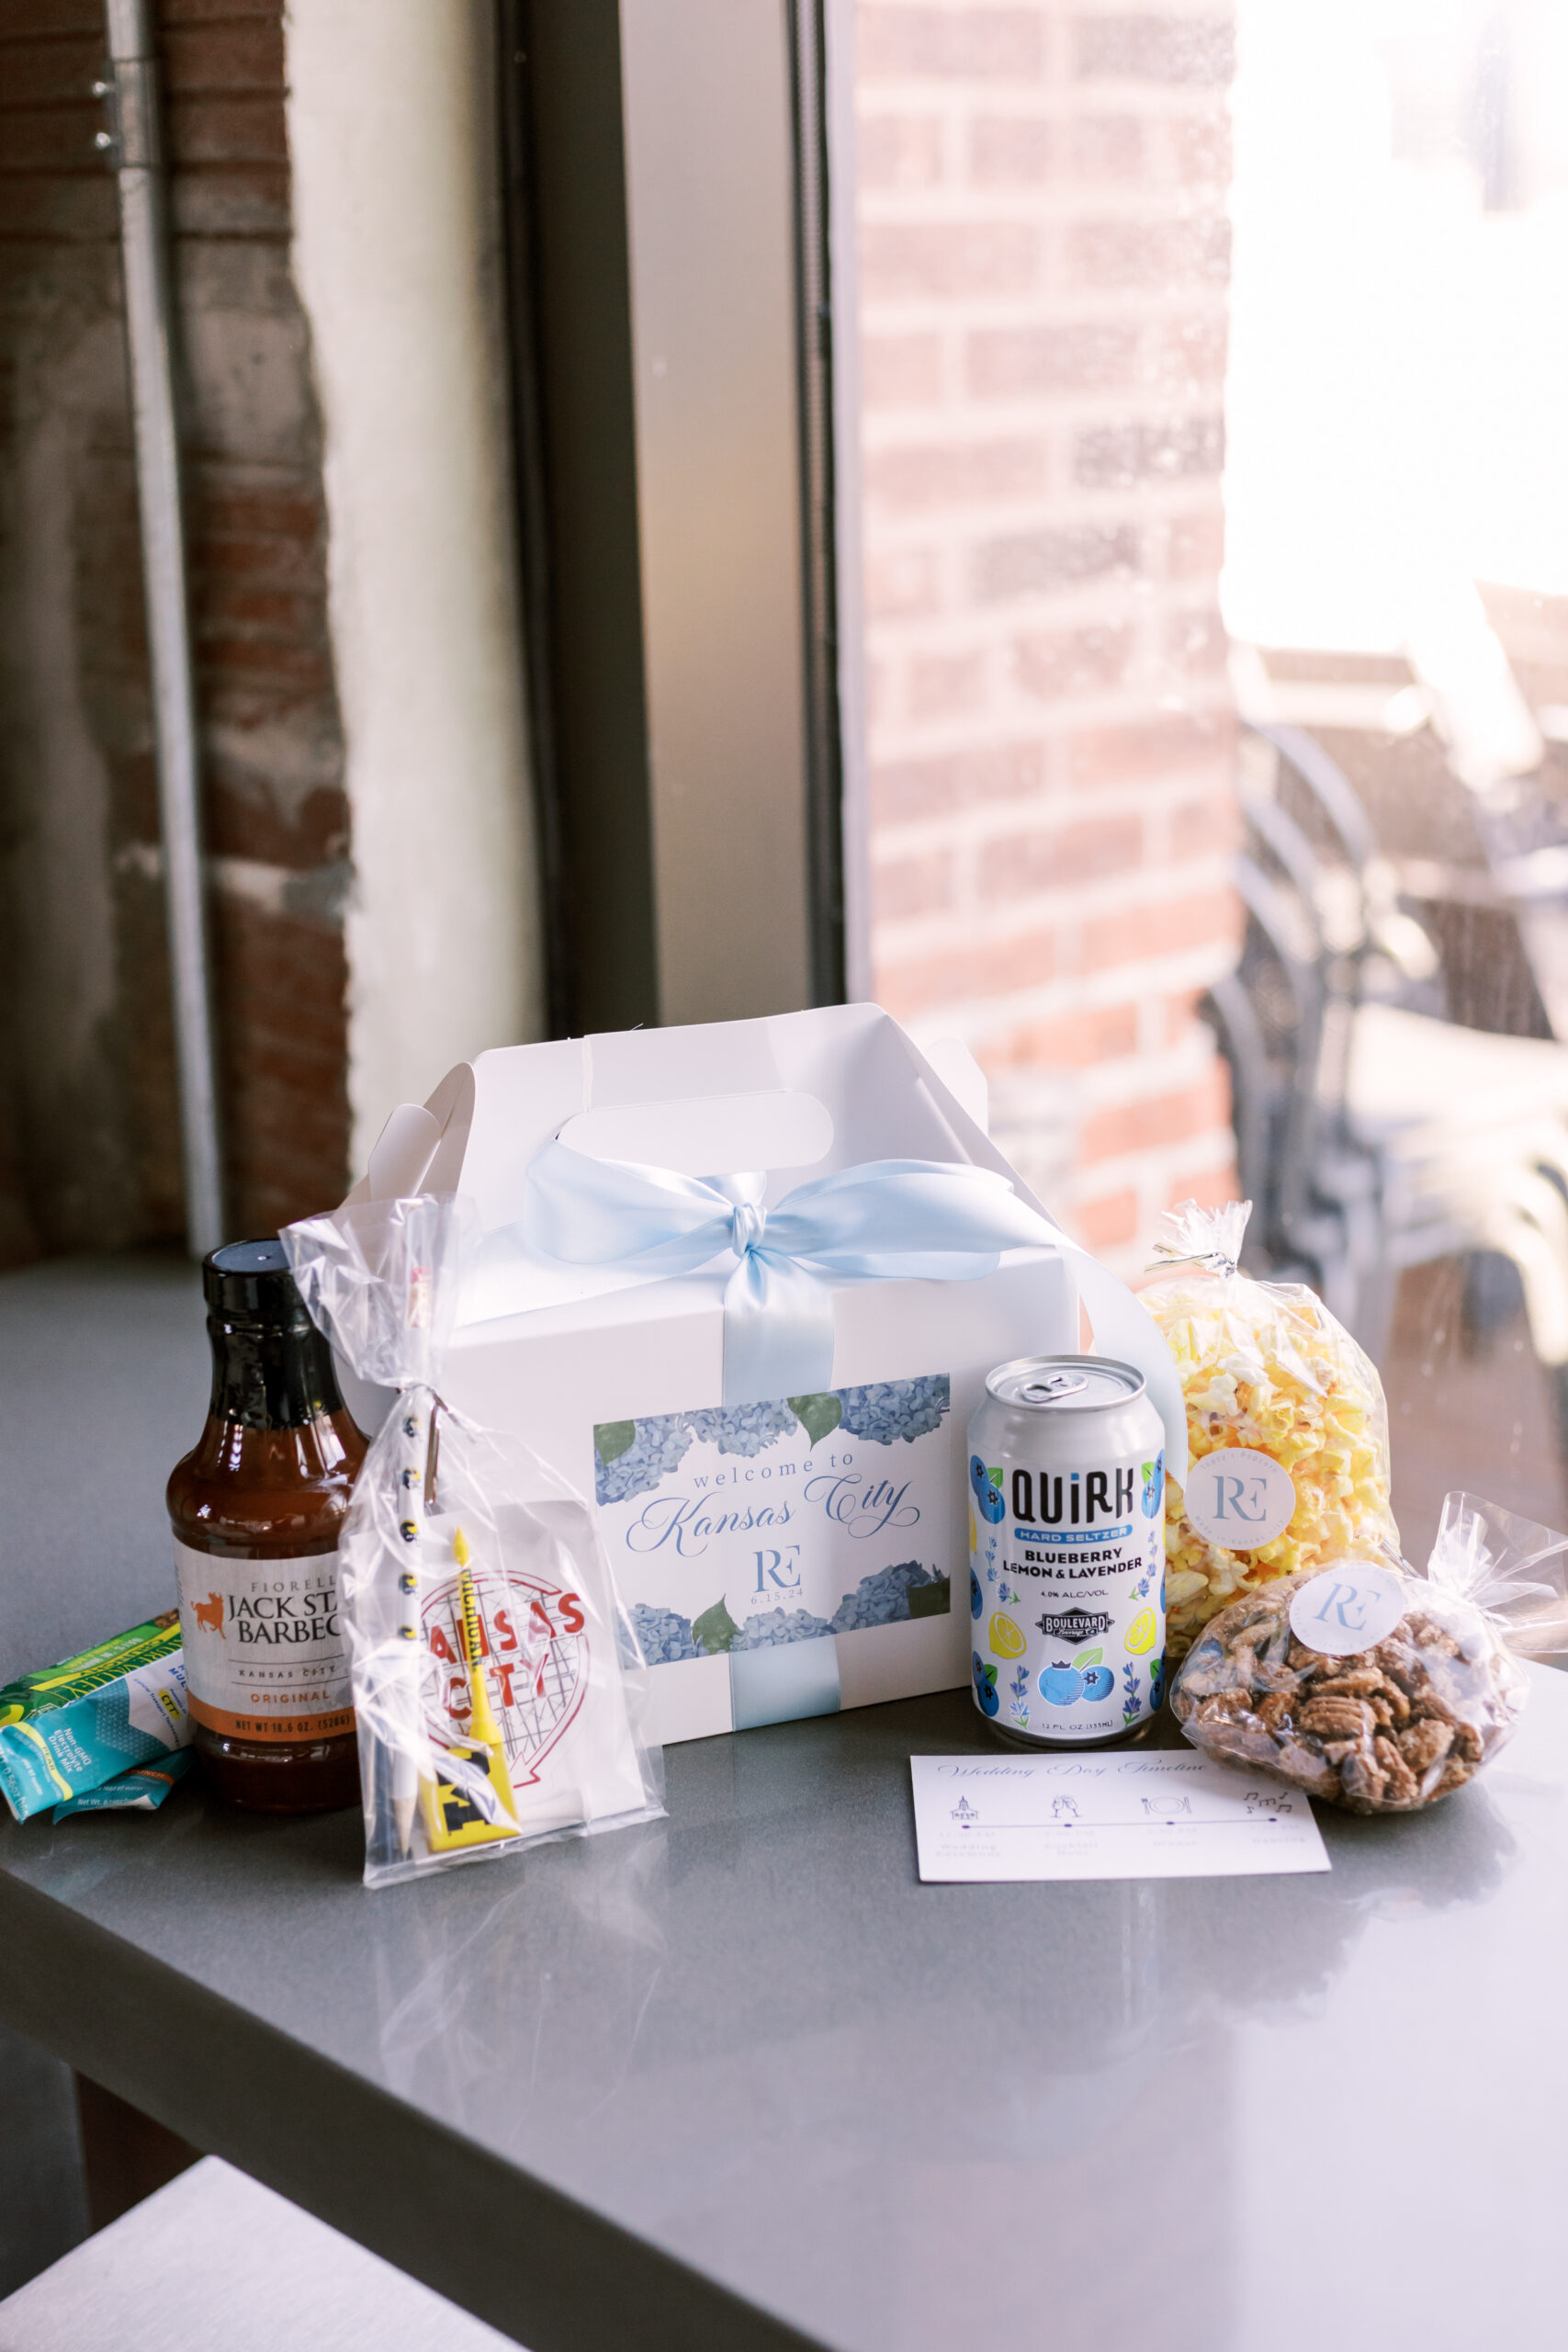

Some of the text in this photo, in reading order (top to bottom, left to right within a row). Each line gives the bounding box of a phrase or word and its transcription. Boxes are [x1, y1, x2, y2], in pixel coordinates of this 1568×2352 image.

[694, 1453, 854, 1489] welcome to
[626, 1473, 921, 1558] Kansas City
[1020, 1527, 1128, 1543] HARD SELTZER
[1024, 1547, 1122, 1564] BLUEBERRY
[1003, 1556, 1143, 1579] LEMON & LAVENDER
[251, 1575, 337, 1593] FIORELL
[1041, 1589, 1110, 1599] 4.0% ALC/VOL
[227, 1590, 339, 1622] JACK ST
[750, 1589, 804, 1605] 6.15.24
[237, 1612, 344, 1645] BARBEC
[429, 1592, 586, 1665] ANSAS
[1045, 1614, 1107, 1633] BOULEVARD
[239, 1664, 336, 1679] KANSAS CITY
[251, 1691, 331, 1703] ORIGINAL
[445, 1653, 550, 1721] CTY
[235, 1719, 252, 1731] NET
[255, 1721, 268, 1732] WT
[272, 1722, 293, 1734] 18.6
[49, 1736, 73, 1774] Drink Mix
[54, 1729, 84, 1772] Electrolyte
[63, 1727, 92, 1766] Non-GMO
[42, 1746, 55, 1771] PEAR
[937, 1758, 1207, 1778] Wedding Day Timeline
